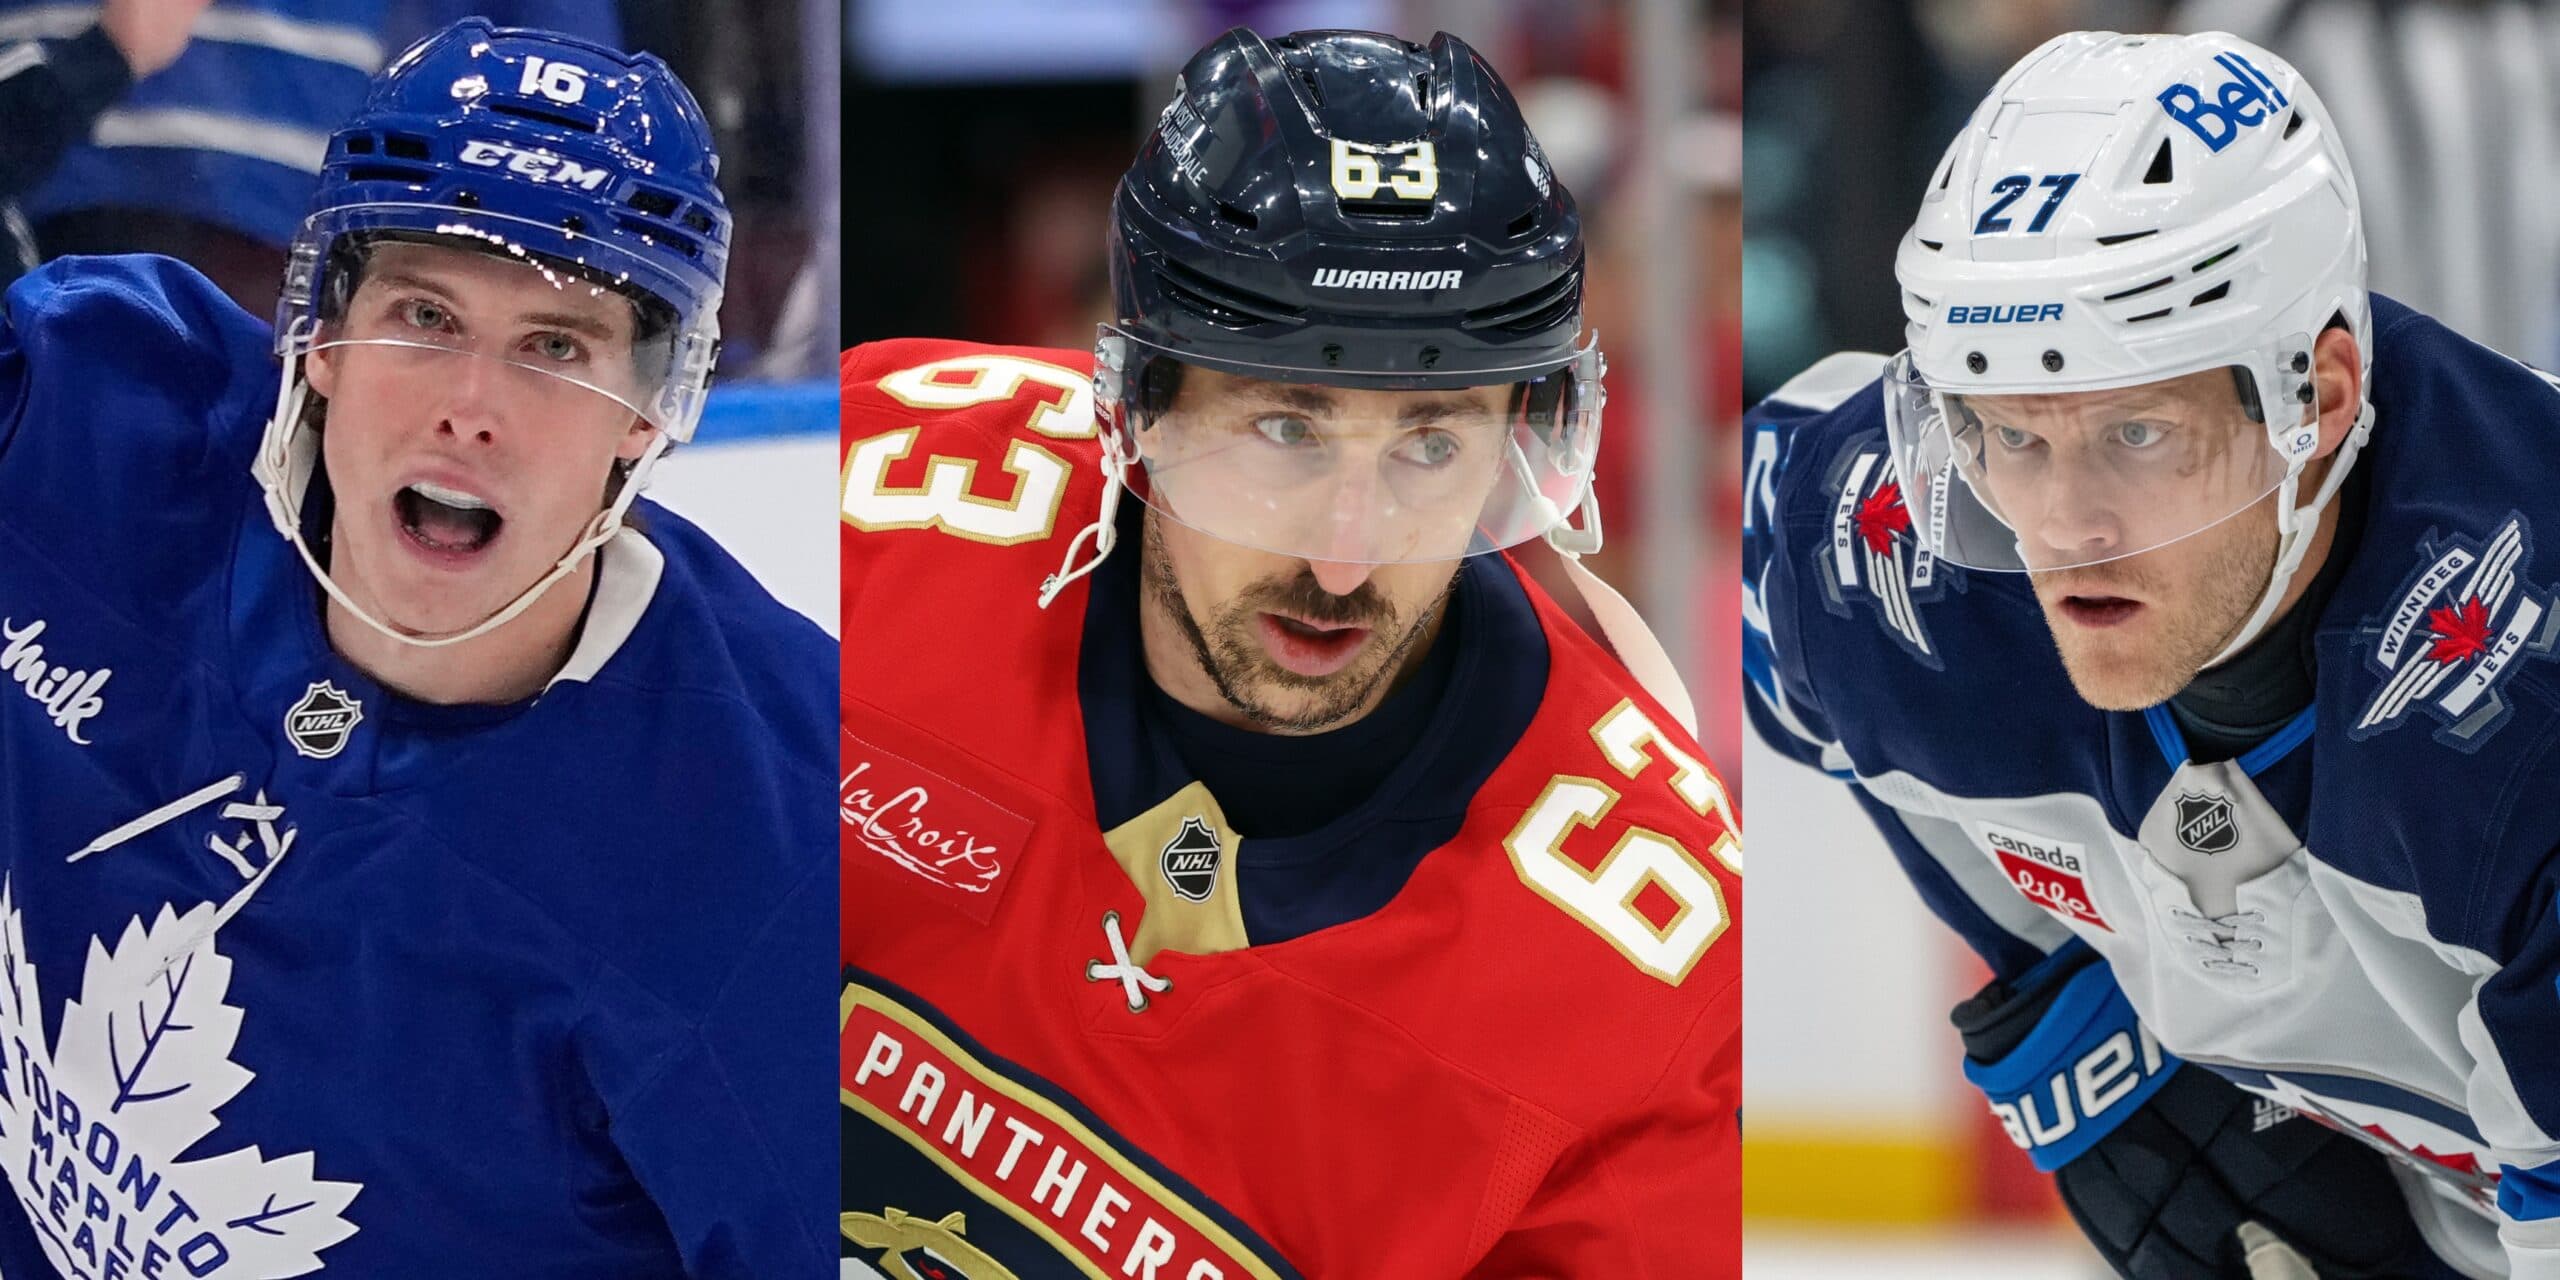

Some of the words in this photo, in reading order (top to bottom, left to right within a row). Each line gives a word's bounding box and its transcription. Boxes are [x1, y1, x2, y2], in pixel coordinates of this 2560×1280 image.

[518, 55, 588, 104] 16
[2157, 51, 2289, 154] Bell
[459, 140, 609, 190] CCM
[1160, 120, 1208, 188] LAUDERDALE
[1331, 138, 1440, 200] 63
[1974, 173, 2082, 236] 27
[1312, 268, 1463, 290] WARRIOR
[840, 354, 1100, 547] 63
[1837, 488, 1856, 549] JETS
[2384, 556, 2464, 655] WINNIPEG
[2475, 631, 2519, 686] JETS
[297, 713, 345, 731] NHL
[1502, 697, 1743, 988] 63
[1987, 831, 2081, 872] canada
[2188, 810, 2227, 843] NHL
[1171, 854, 1214, 870] NHL
[2018, 870, 2099, 917] life
[14, 1035, 229, 1279] TORONTO
[32, 1109, 171, 1280] MAPLE
